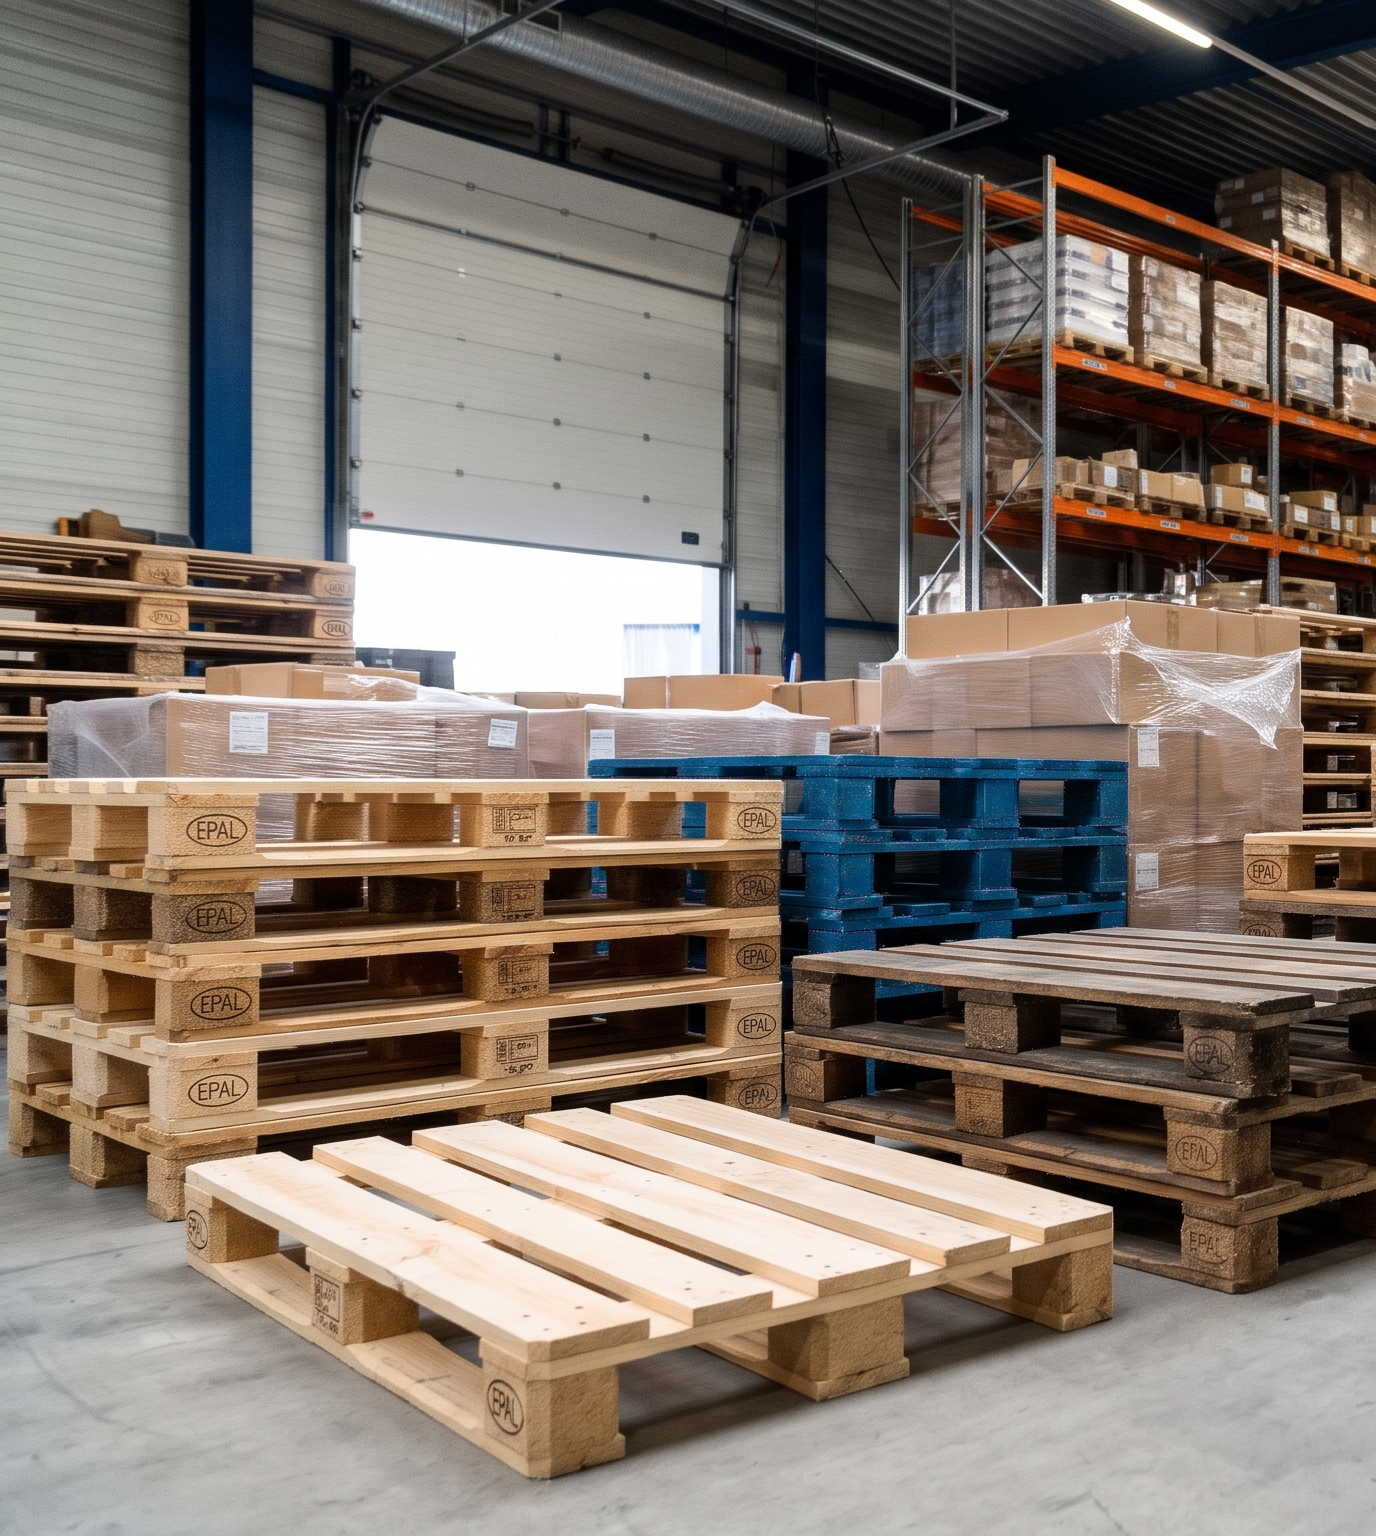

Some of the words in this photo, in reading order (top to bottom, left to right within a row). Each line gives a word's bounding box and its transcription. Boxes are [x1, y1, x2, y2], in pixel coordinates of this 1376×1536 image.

[196, 820, 240, 840] EPAL
[743, 812, 772, 828] EPAL
[1252, 864, 1277, 880] EPAL
[742, 880, 770, 896] EPAL
[196, 907, 240, 928] EPAL
[743, 949, 771, 965] EPAL
[201, 993, 244, 1014] EPAL
[743, 1017, 772, 1034] EPAL
[1194, 1042, 1229, 1066] EPAL
[198, 1080, 241, 1101] EPAL
[744, 1087, 773, 1105] EPAL
[1182, 1141, 1212, 1165] EPAL
[492, 1386, 519, 1429] EPAL
